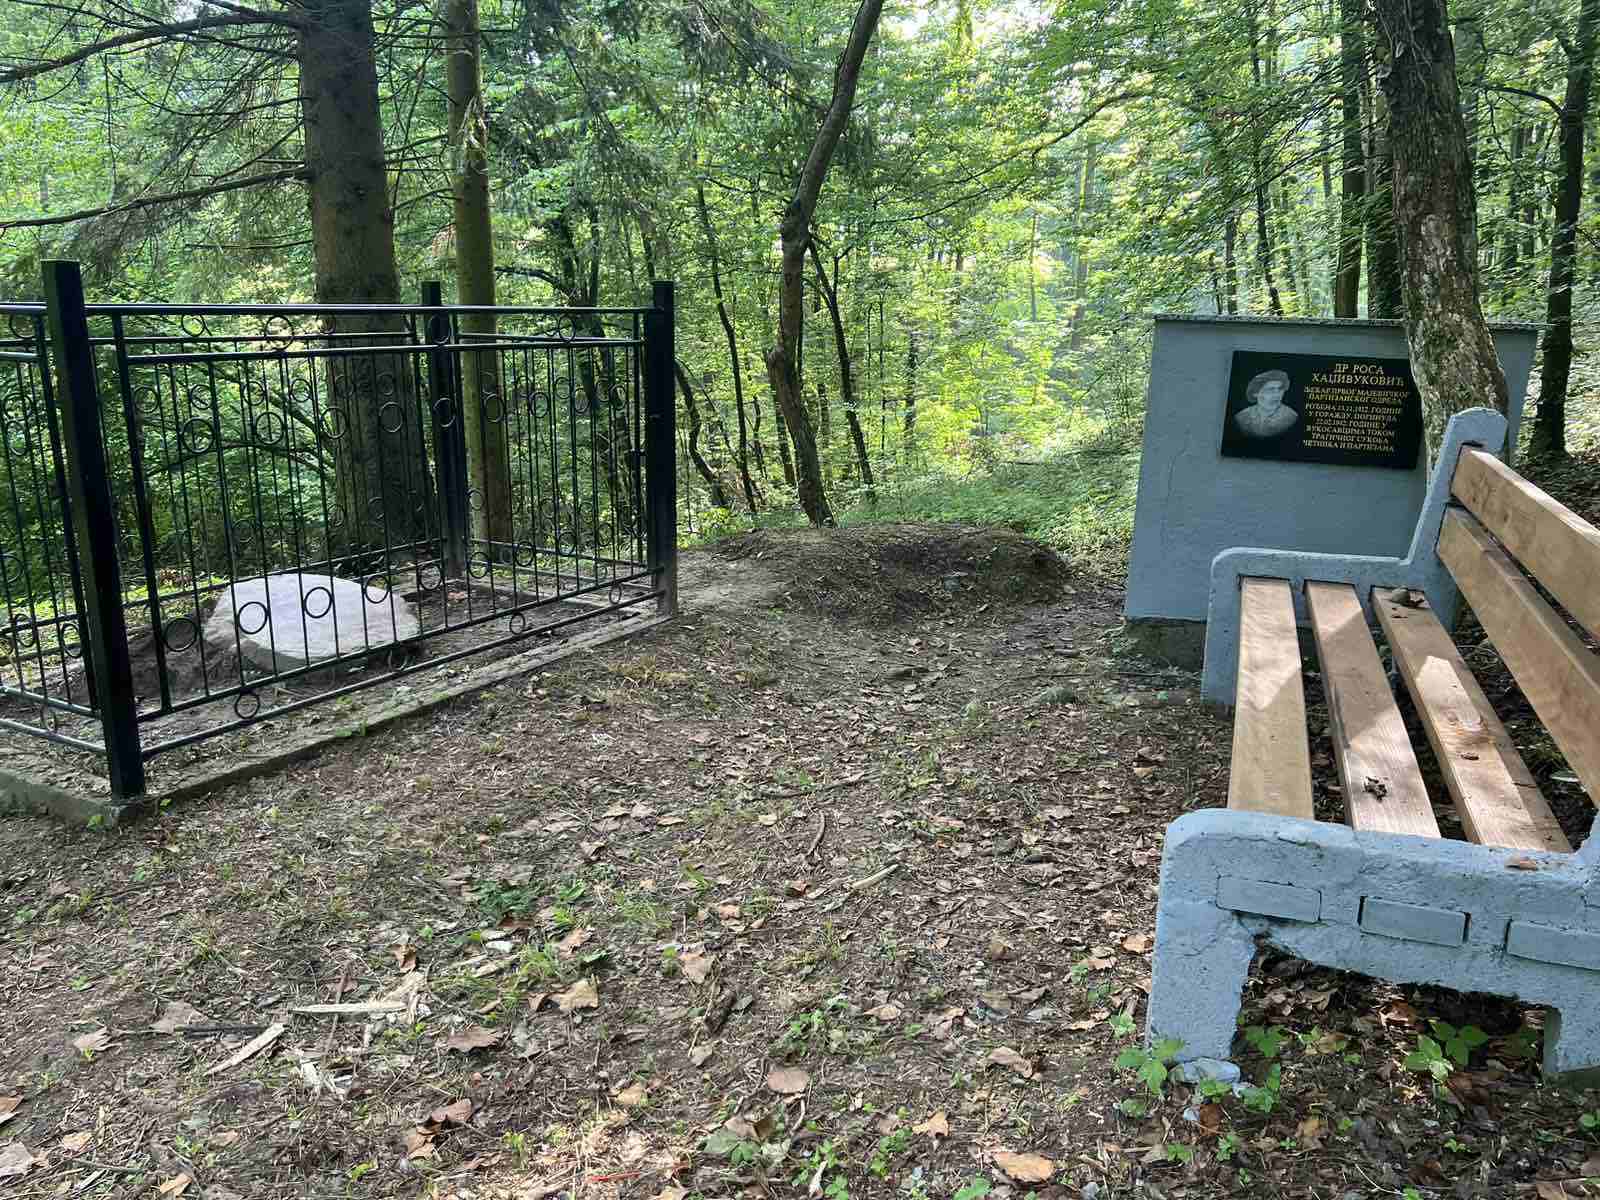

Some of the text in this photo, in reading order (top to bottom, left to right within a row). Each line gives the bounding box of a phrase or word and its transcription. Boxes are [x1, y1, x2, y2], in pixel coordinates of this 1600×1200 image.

[1334, 363, 1384, 375] ДР РОСА
[1311, 372, 1404, 386] ХАЏИВУКОВИЋ
[1308, 393, 1370, 402] ПАРТИЗАНСКОГ
[1371, 406, 1402, 414] ГОДИНЕ
[1354, 413, 1397, 422] ПОГИНУЛА
[1349, 420, 1380, 428] ГОДИНЕ
[1367, 429, 1395, 437] ТОКОМ
[1311, 433, 1389, 444] ТРАГИЧНОГ СУКОБА
[1303, 439, 1338, 448] ЧЕТНИКА
